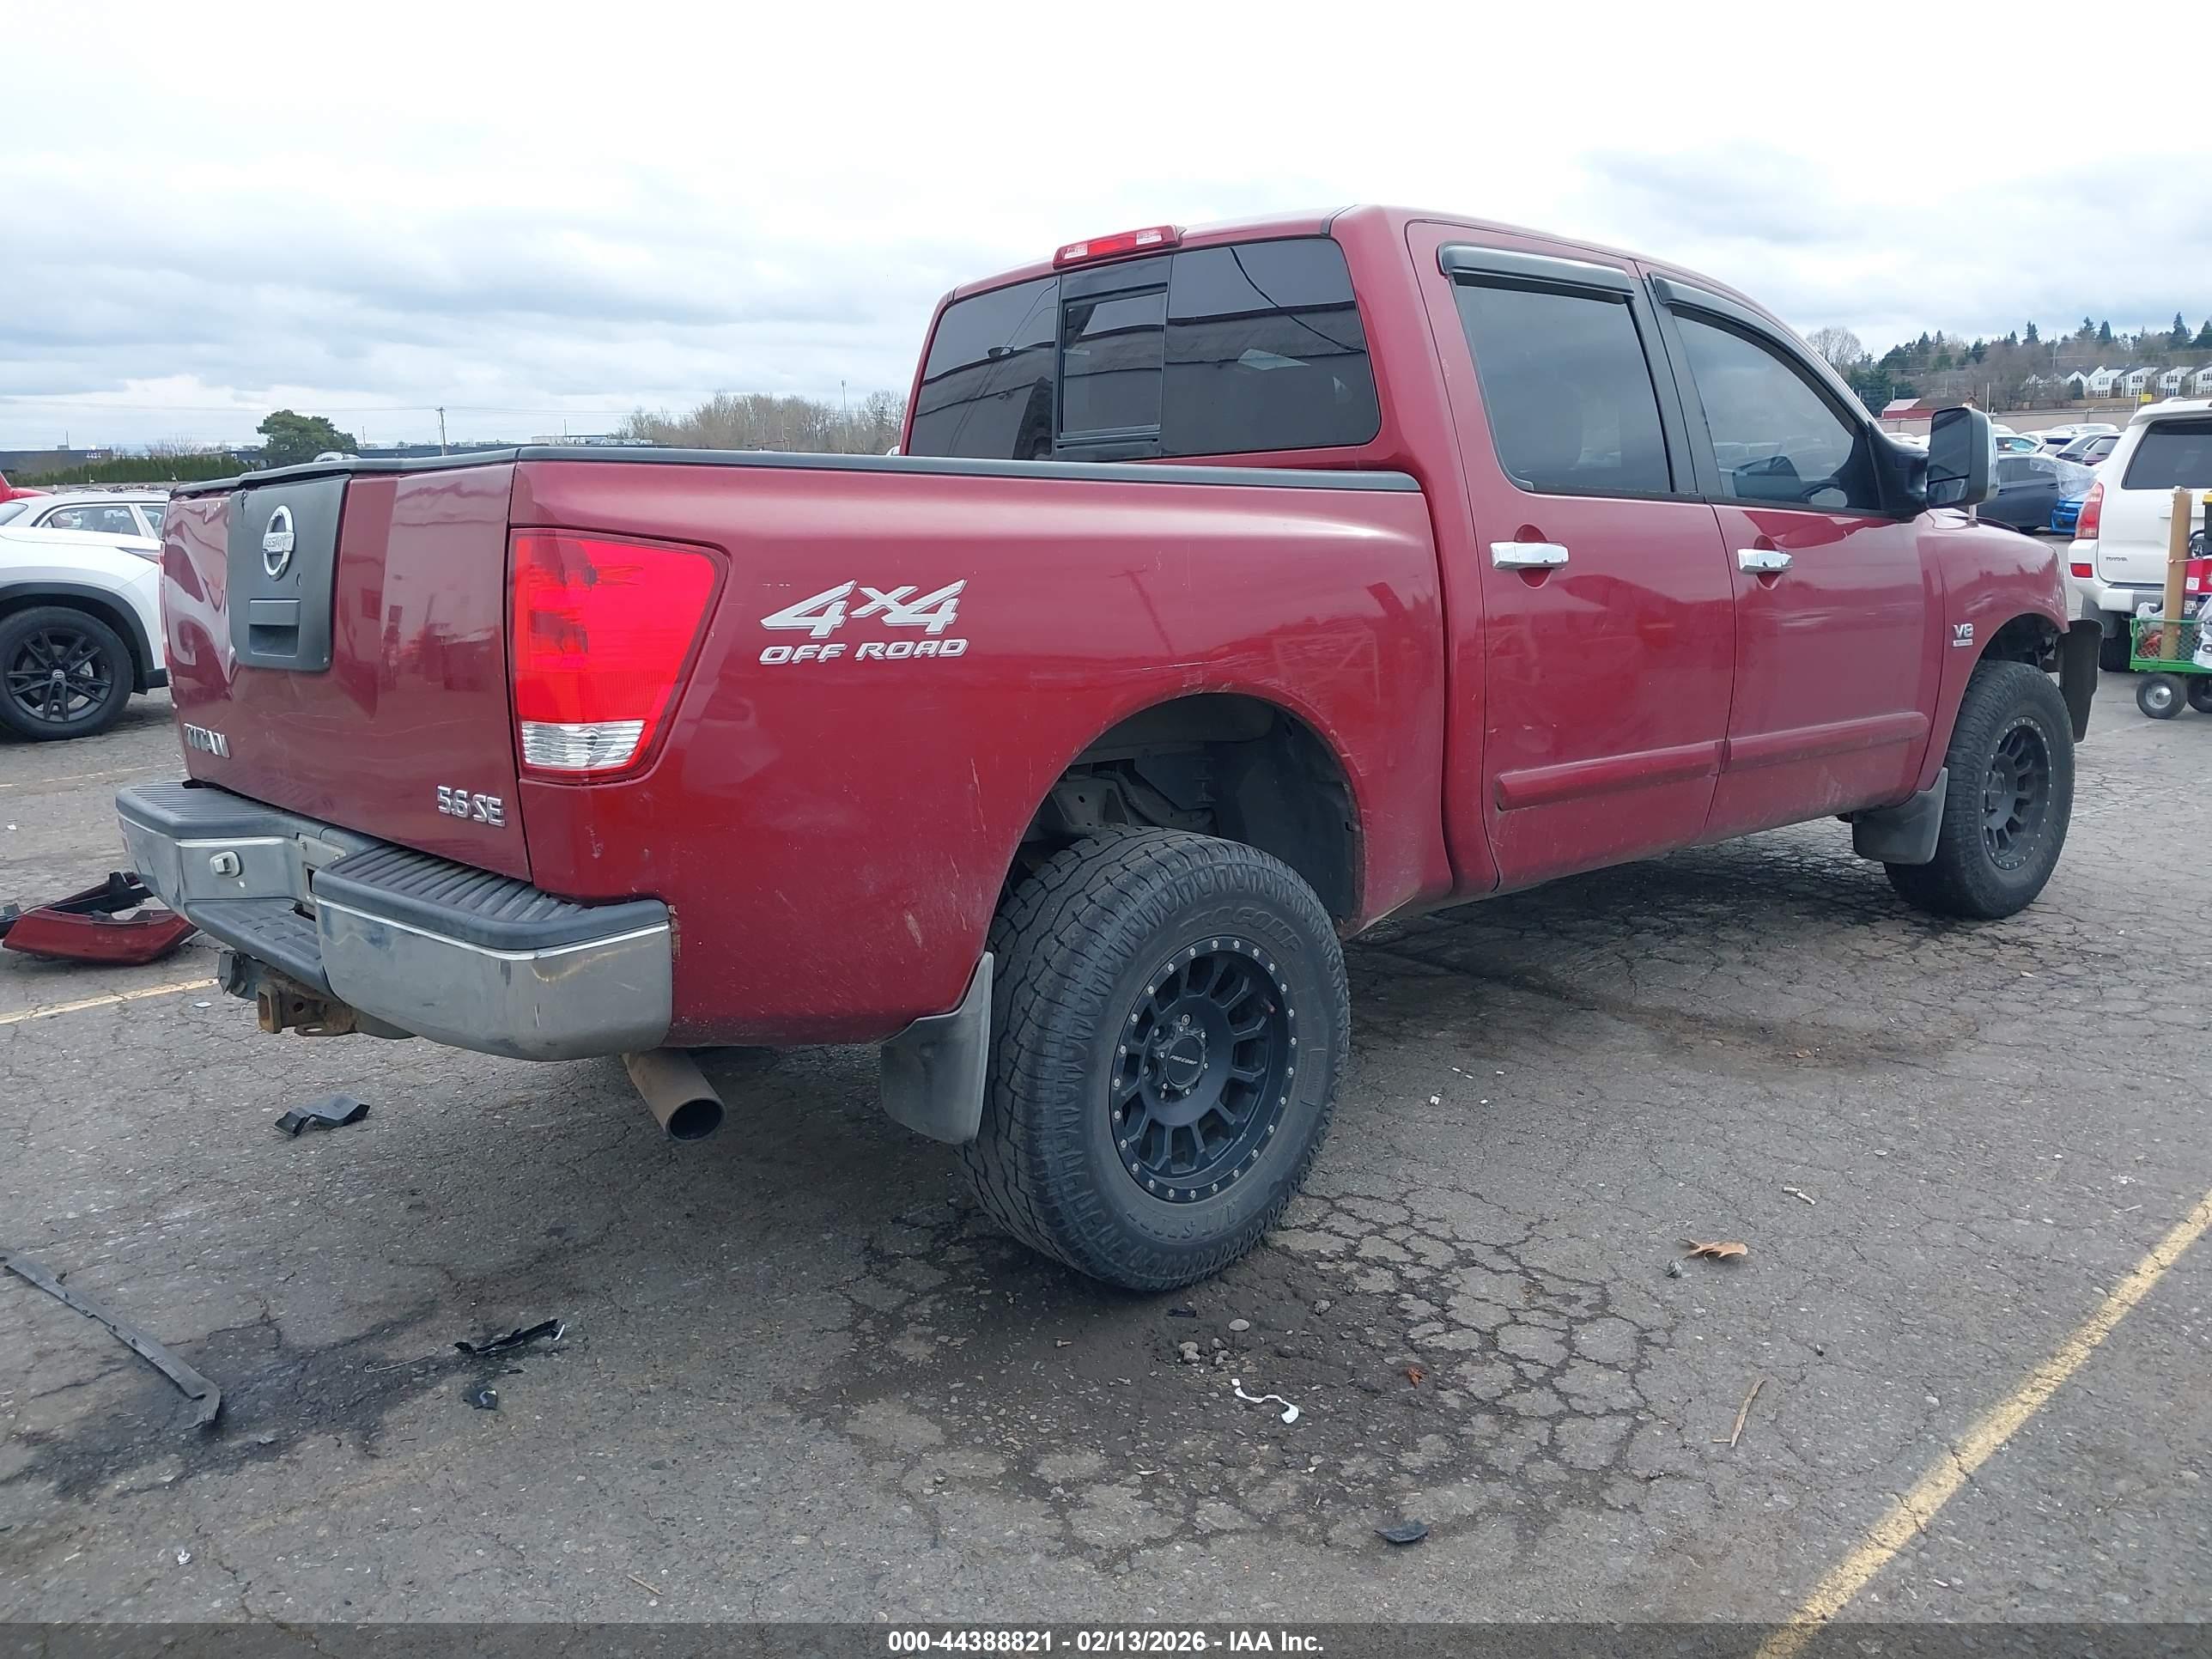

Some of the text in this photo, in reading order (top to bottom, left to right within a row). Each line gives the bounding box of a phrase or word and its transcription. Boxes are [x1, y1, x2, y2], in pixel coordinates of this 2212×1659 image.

[1953, 623, 1974, 638] V8
[759, 639, 969, 665] OFF ROAD
[437, 785, 506, 827] 5.6 SE
